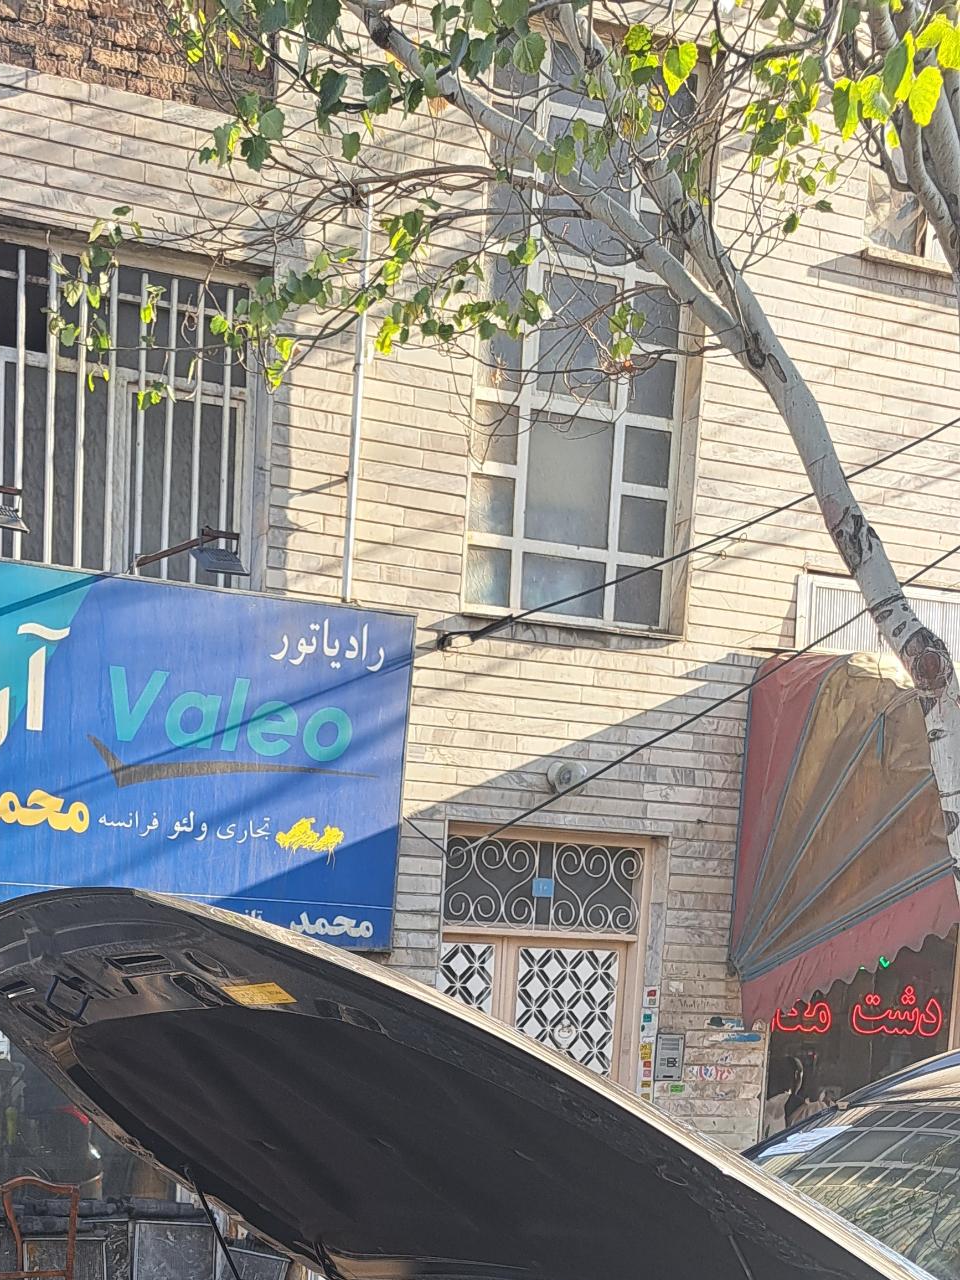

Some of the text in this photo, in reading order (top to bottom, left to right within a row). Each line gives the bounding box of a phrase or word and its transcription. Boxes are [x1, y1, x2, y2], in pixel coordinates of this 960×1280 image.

[270, 618, 385, 672] رادیاتور
[109, 665, 354, 762] Valeo
[98, 810, 160, 838] فرانسه
[216, 816, 273, 844] تجاری
[290, 911, 374, 938] محمد
[852, 985, 942, 1036] دشت
